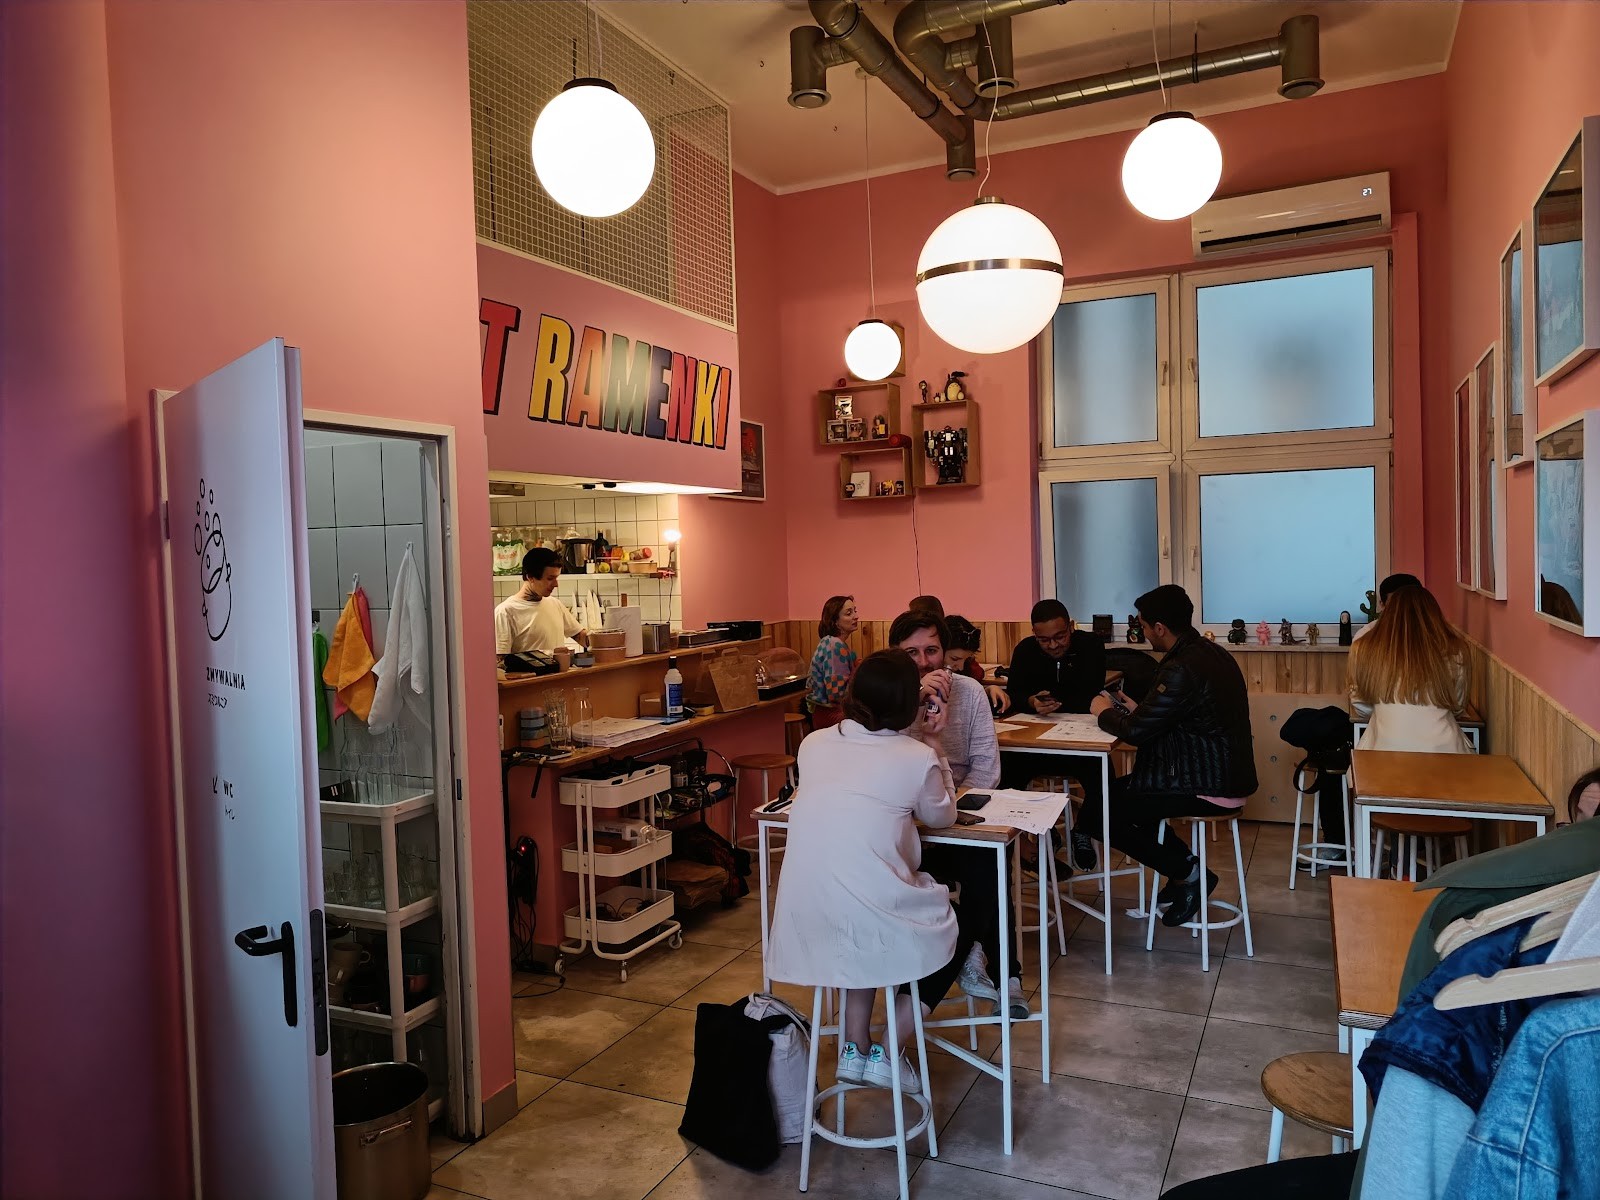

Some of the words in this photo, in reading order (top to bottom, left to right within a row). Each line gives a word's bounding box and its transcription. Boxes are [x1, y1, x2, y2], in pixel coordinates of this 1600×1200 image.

[1362, 187, 1372, 196] 27
[528, 313, 732, 450] RAMENKI
[206, 666, 246, 691] ZMYWALNIA
[223, 780, 234, 799] WC
